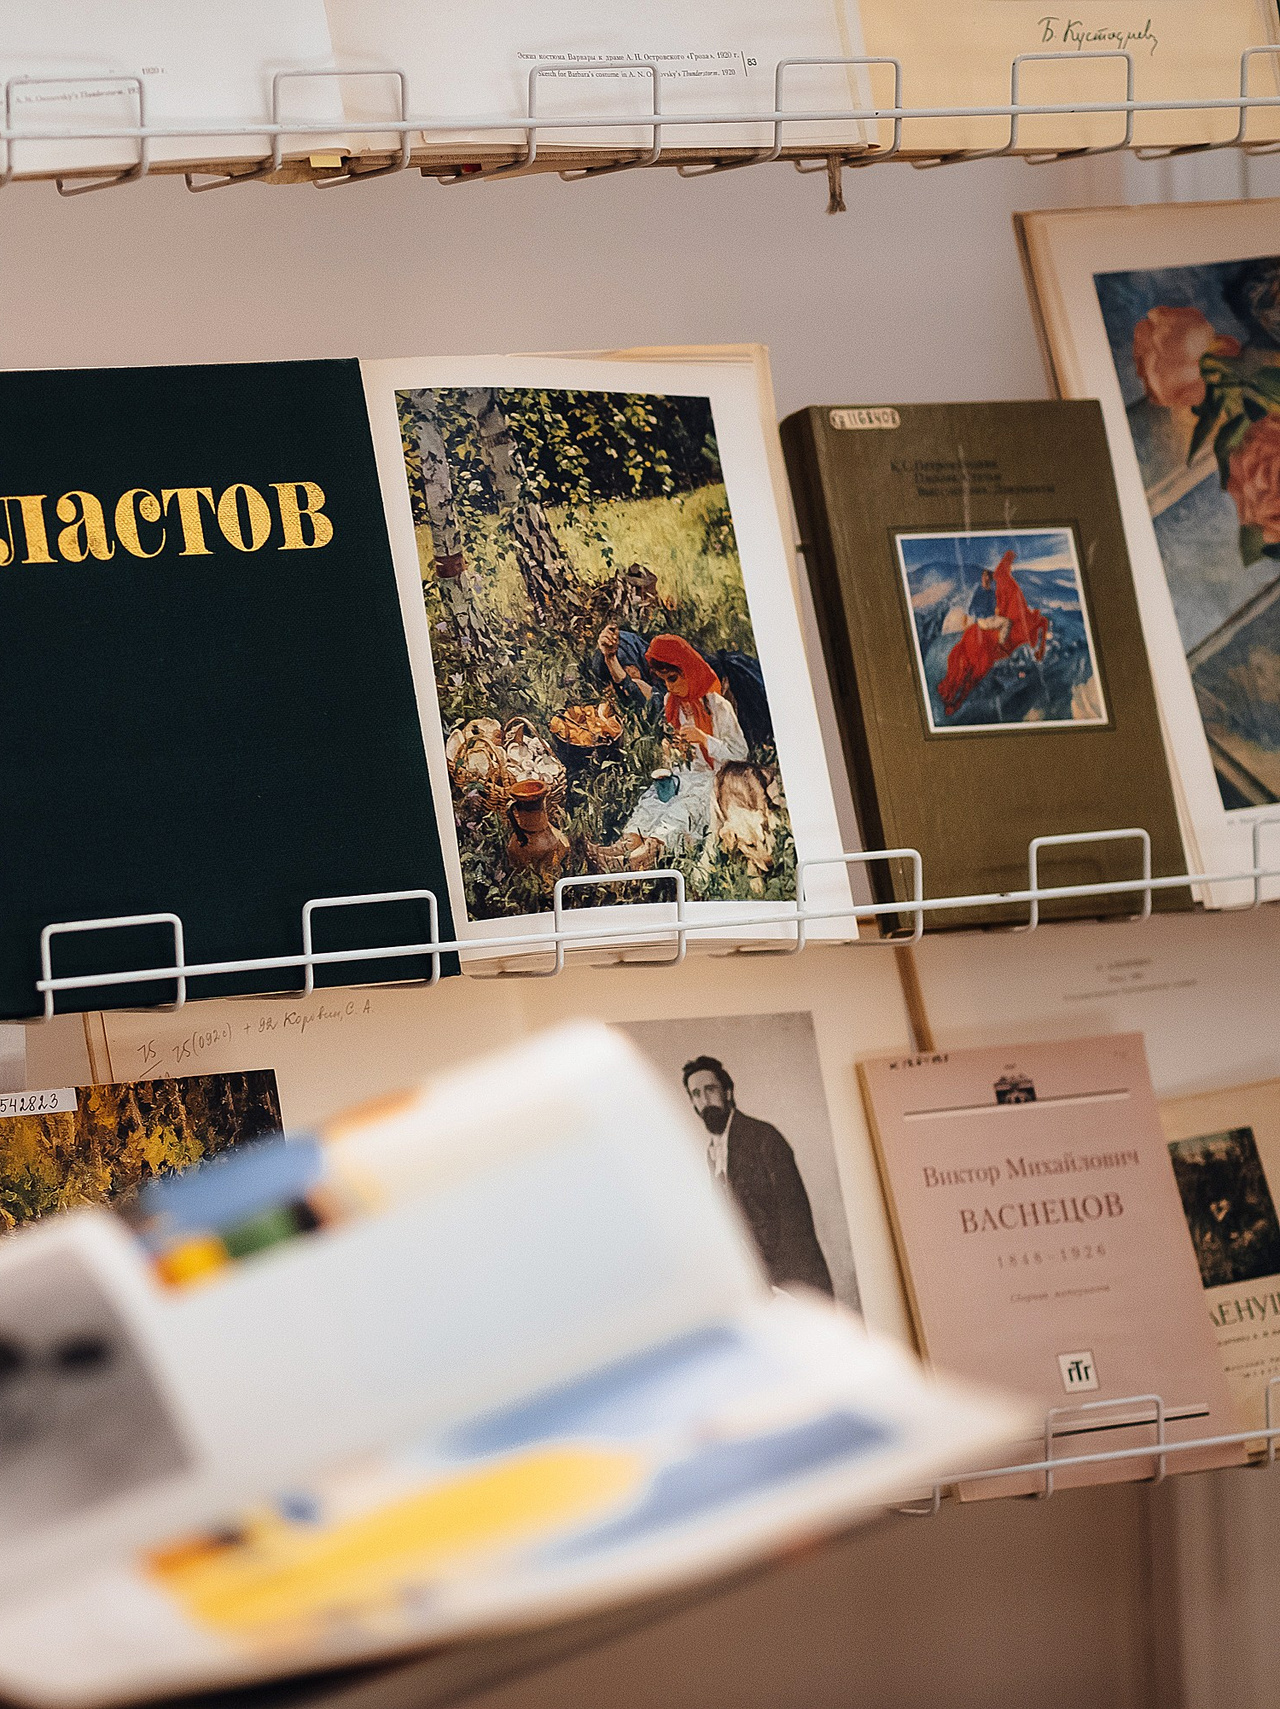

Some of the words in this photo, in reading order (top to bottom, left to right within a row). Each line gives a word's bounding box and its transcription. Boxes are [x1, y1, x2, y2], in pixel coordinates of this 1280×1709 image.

[643, 53, 685, 62] Островского
[716, 51, 733, 60] 1920
[747, 58, 758, 67] 83
[721, 68, 736, 77] 1920
[922, 1164, 1001, 1189] Виктор
[1005, 1149, 1140, 1181] Михайлович
[959, 1191, 1125, 1235] ВАСНЕЦОВ
